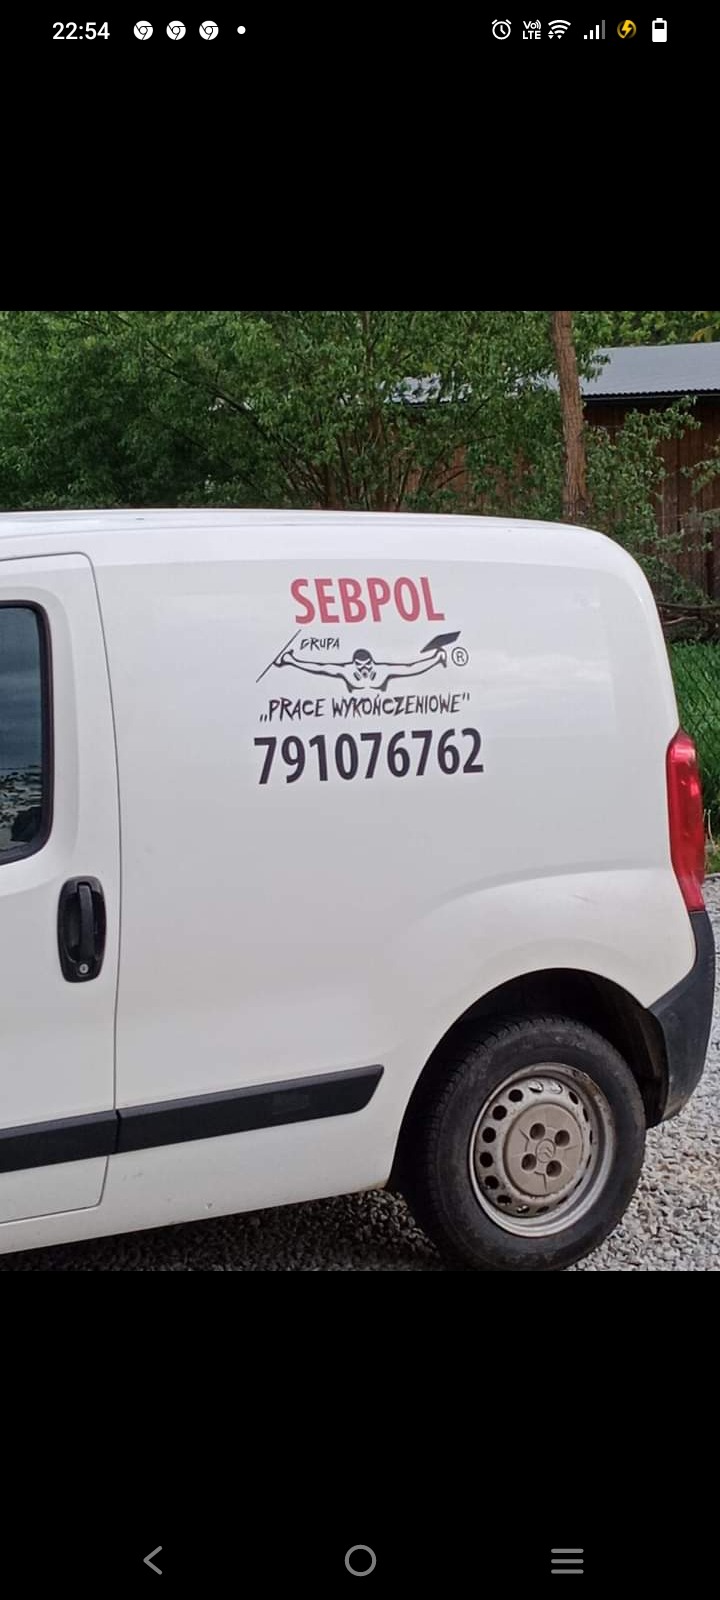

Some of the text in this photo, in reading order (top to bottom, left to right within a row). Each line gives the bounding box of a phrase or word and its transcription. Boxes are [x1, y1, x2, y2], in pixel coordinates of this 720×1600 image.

[290, 576, 446, 624] SEBPOL
[299, 637, 340, 651] GRUPA
[253, 727, 484, 785] 791076762
